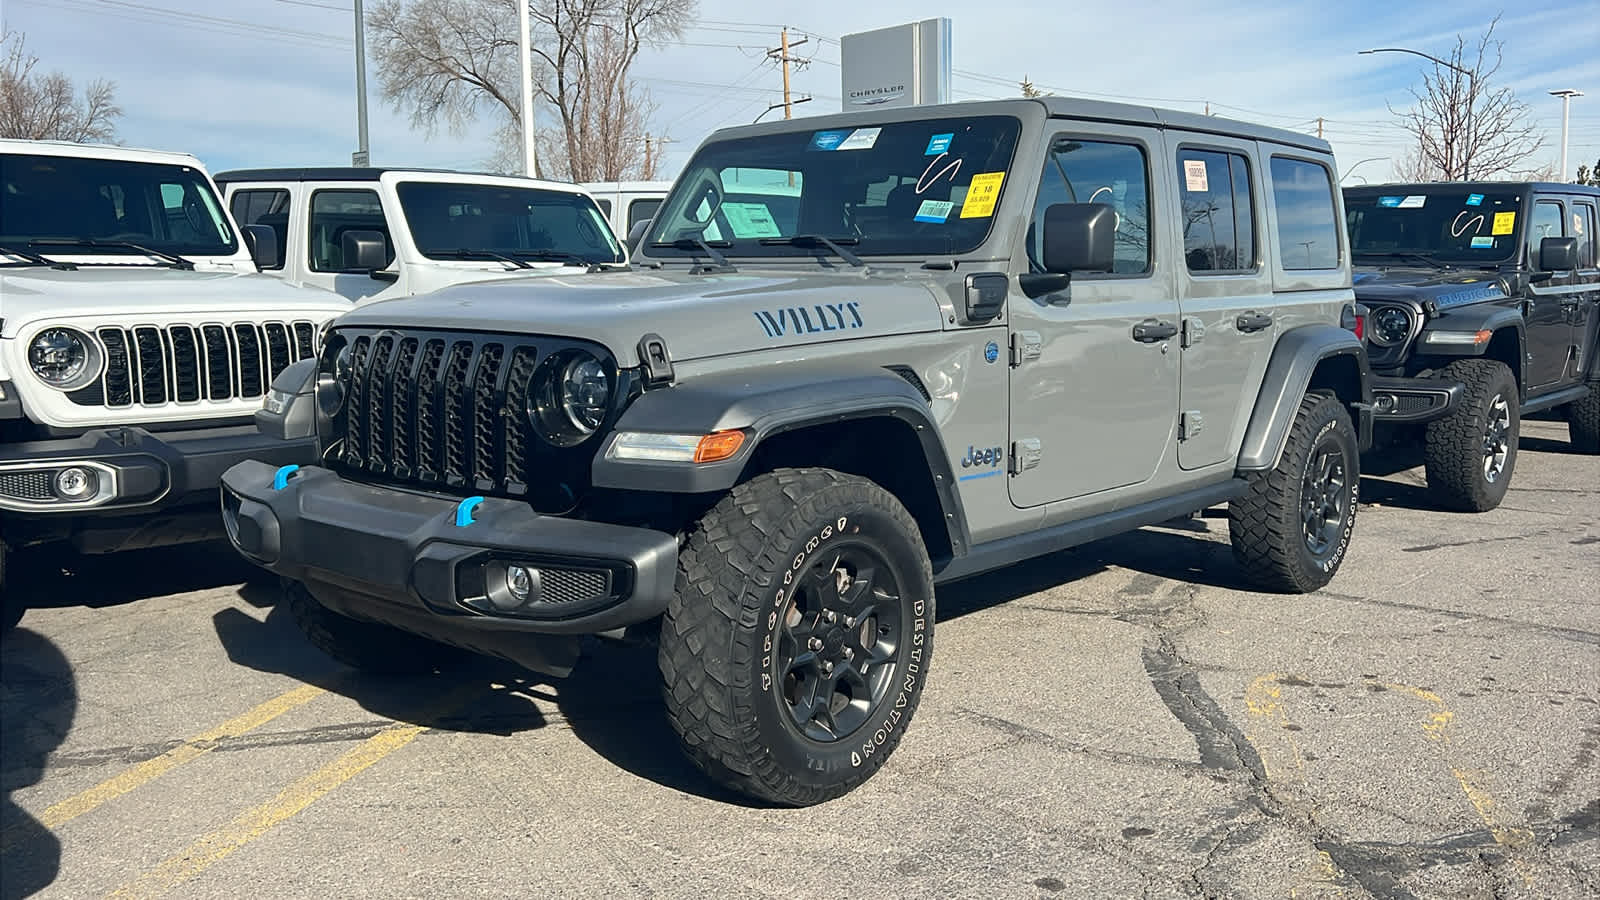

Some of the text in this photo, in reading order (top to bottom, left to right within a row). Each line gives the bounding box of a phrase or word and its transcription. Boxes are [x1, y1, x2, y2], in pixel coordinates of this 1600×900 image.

[850, 85, 904, 98] CHRYSLER
[752, 301, 864, 338] WILLYS
[961, 445, 1003, 468] Jeep
[863, 599, 926, 758] DESTINATION
